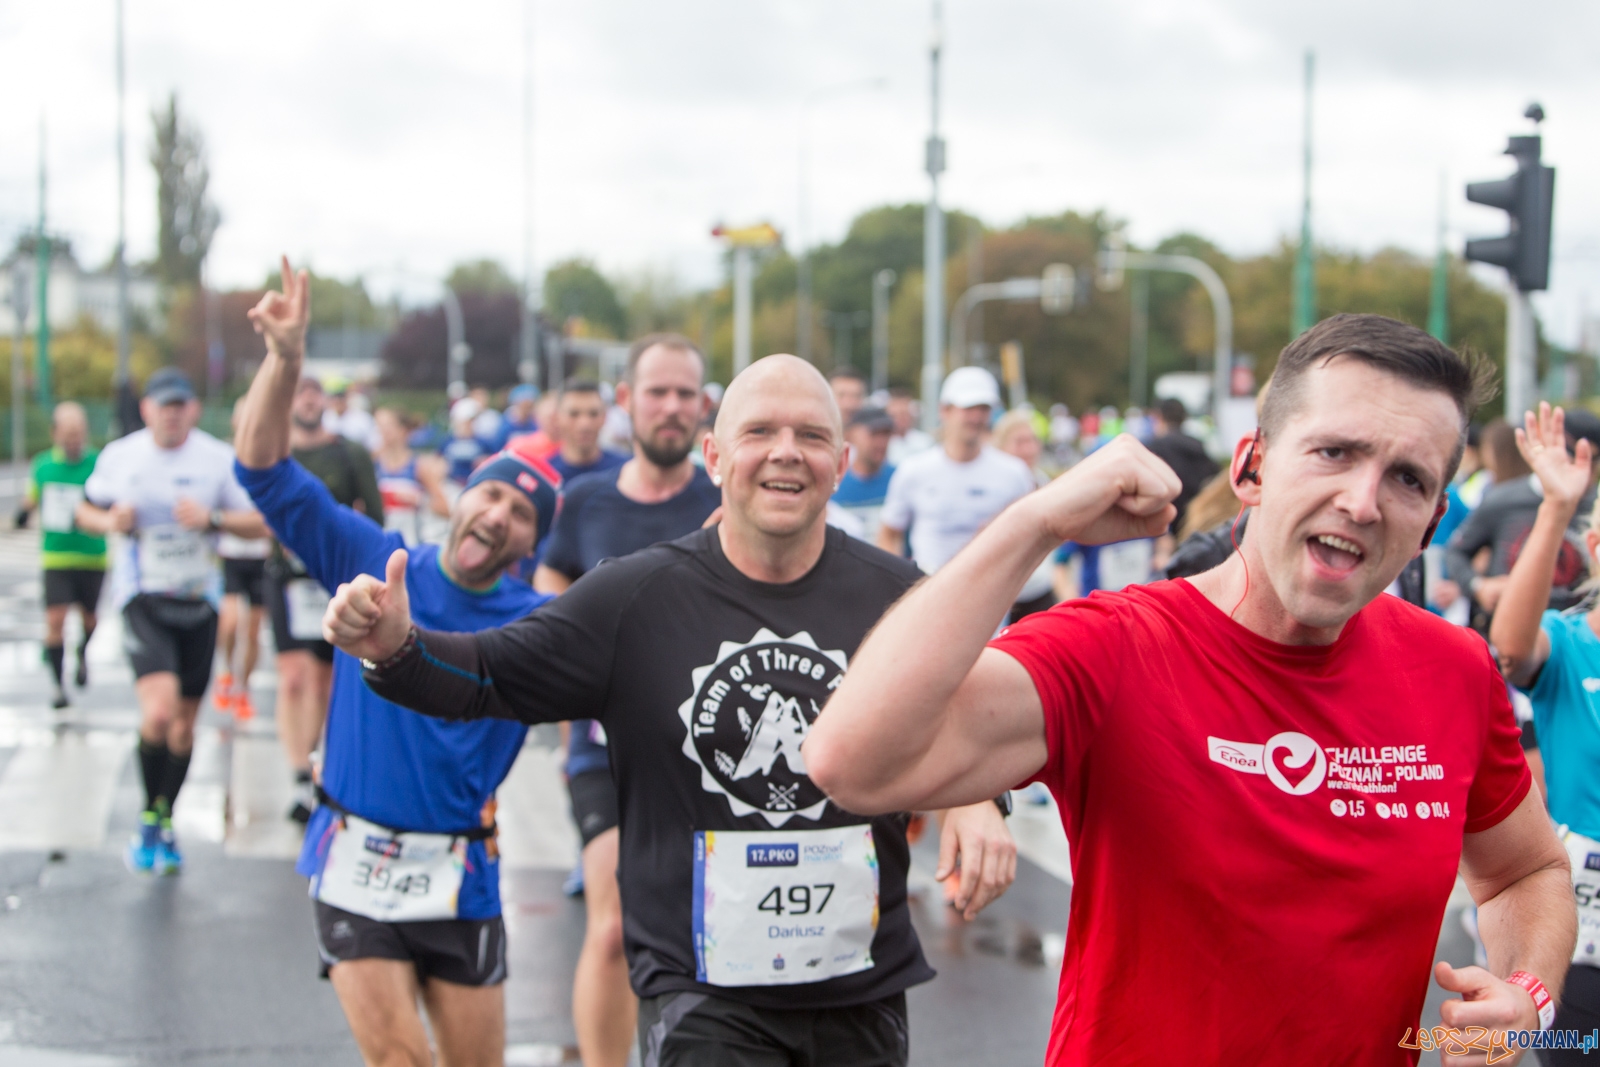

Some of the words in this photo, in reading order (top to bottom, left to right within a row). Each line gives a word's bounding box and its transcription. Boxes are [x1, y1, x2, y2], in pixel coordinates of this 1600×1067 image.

[693, 679, 731, 738] Team
[729, 653, 753, 682] of
[756, 647, 826, 681] Three
[1220, 750, 1257, 767] Enea
[1394, 764, 1445, 781] POLAND
[1327, 780, 1398, 793] weareiathlon!
[1348, 799, 1365, 818] 1,5
[1391, 802, 1409, 819] 40
[1430, 801, 1450, 819] 10,4
[757, 882, 836, 916] 497
[767, 924, 825, 940] Dariusz
